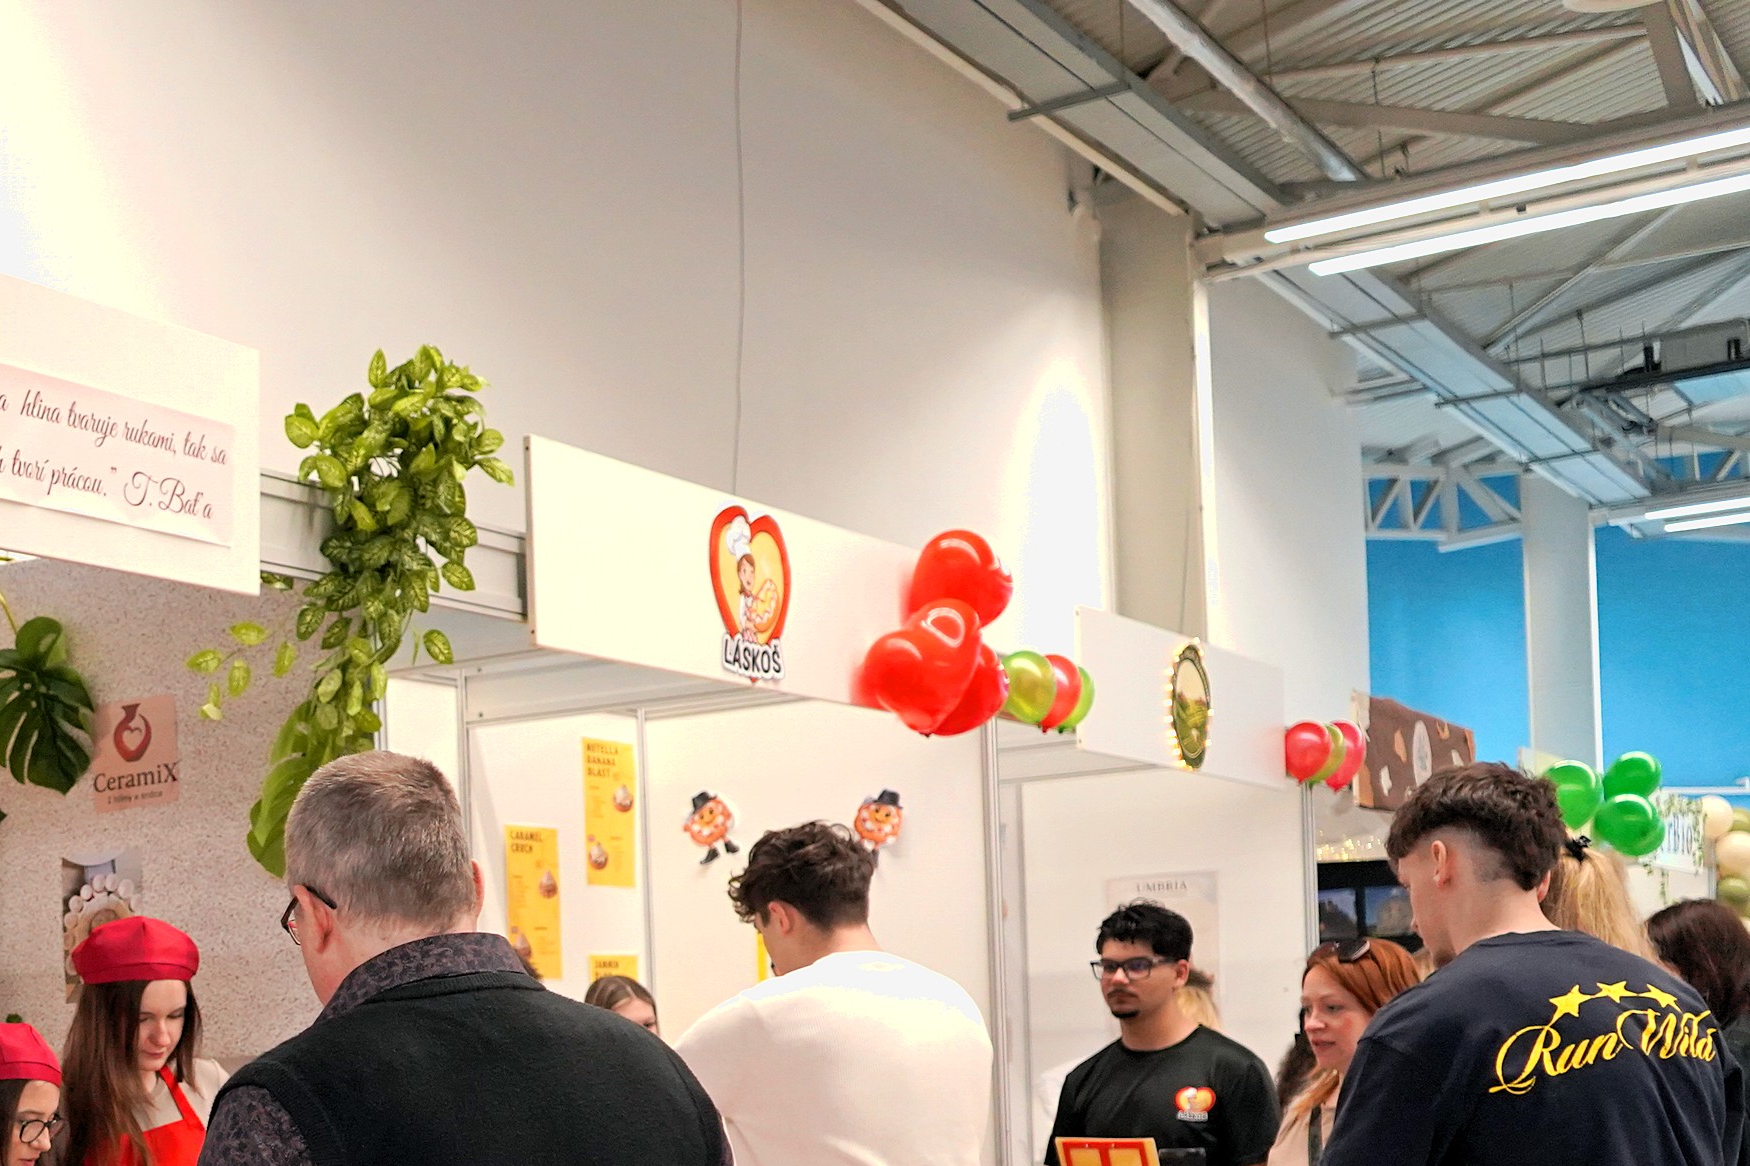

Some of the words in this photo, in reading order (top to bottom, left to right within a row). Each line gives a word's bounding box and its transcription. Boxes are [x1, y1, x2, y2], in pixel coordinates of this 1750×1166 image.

[20, 389, 62, 424] hlina
[67, 401, 119, 447] tvaruje
[124, 419, 177, 456] rukami,
[183, 431, 207, 461] tak
[211, 448, 229, 466] sa
[724, 638, 782, 674] LÁSKOŠ
[94, 761, 180, 793] CeramiX
[1488, 1025, 1624, 1095] Run
